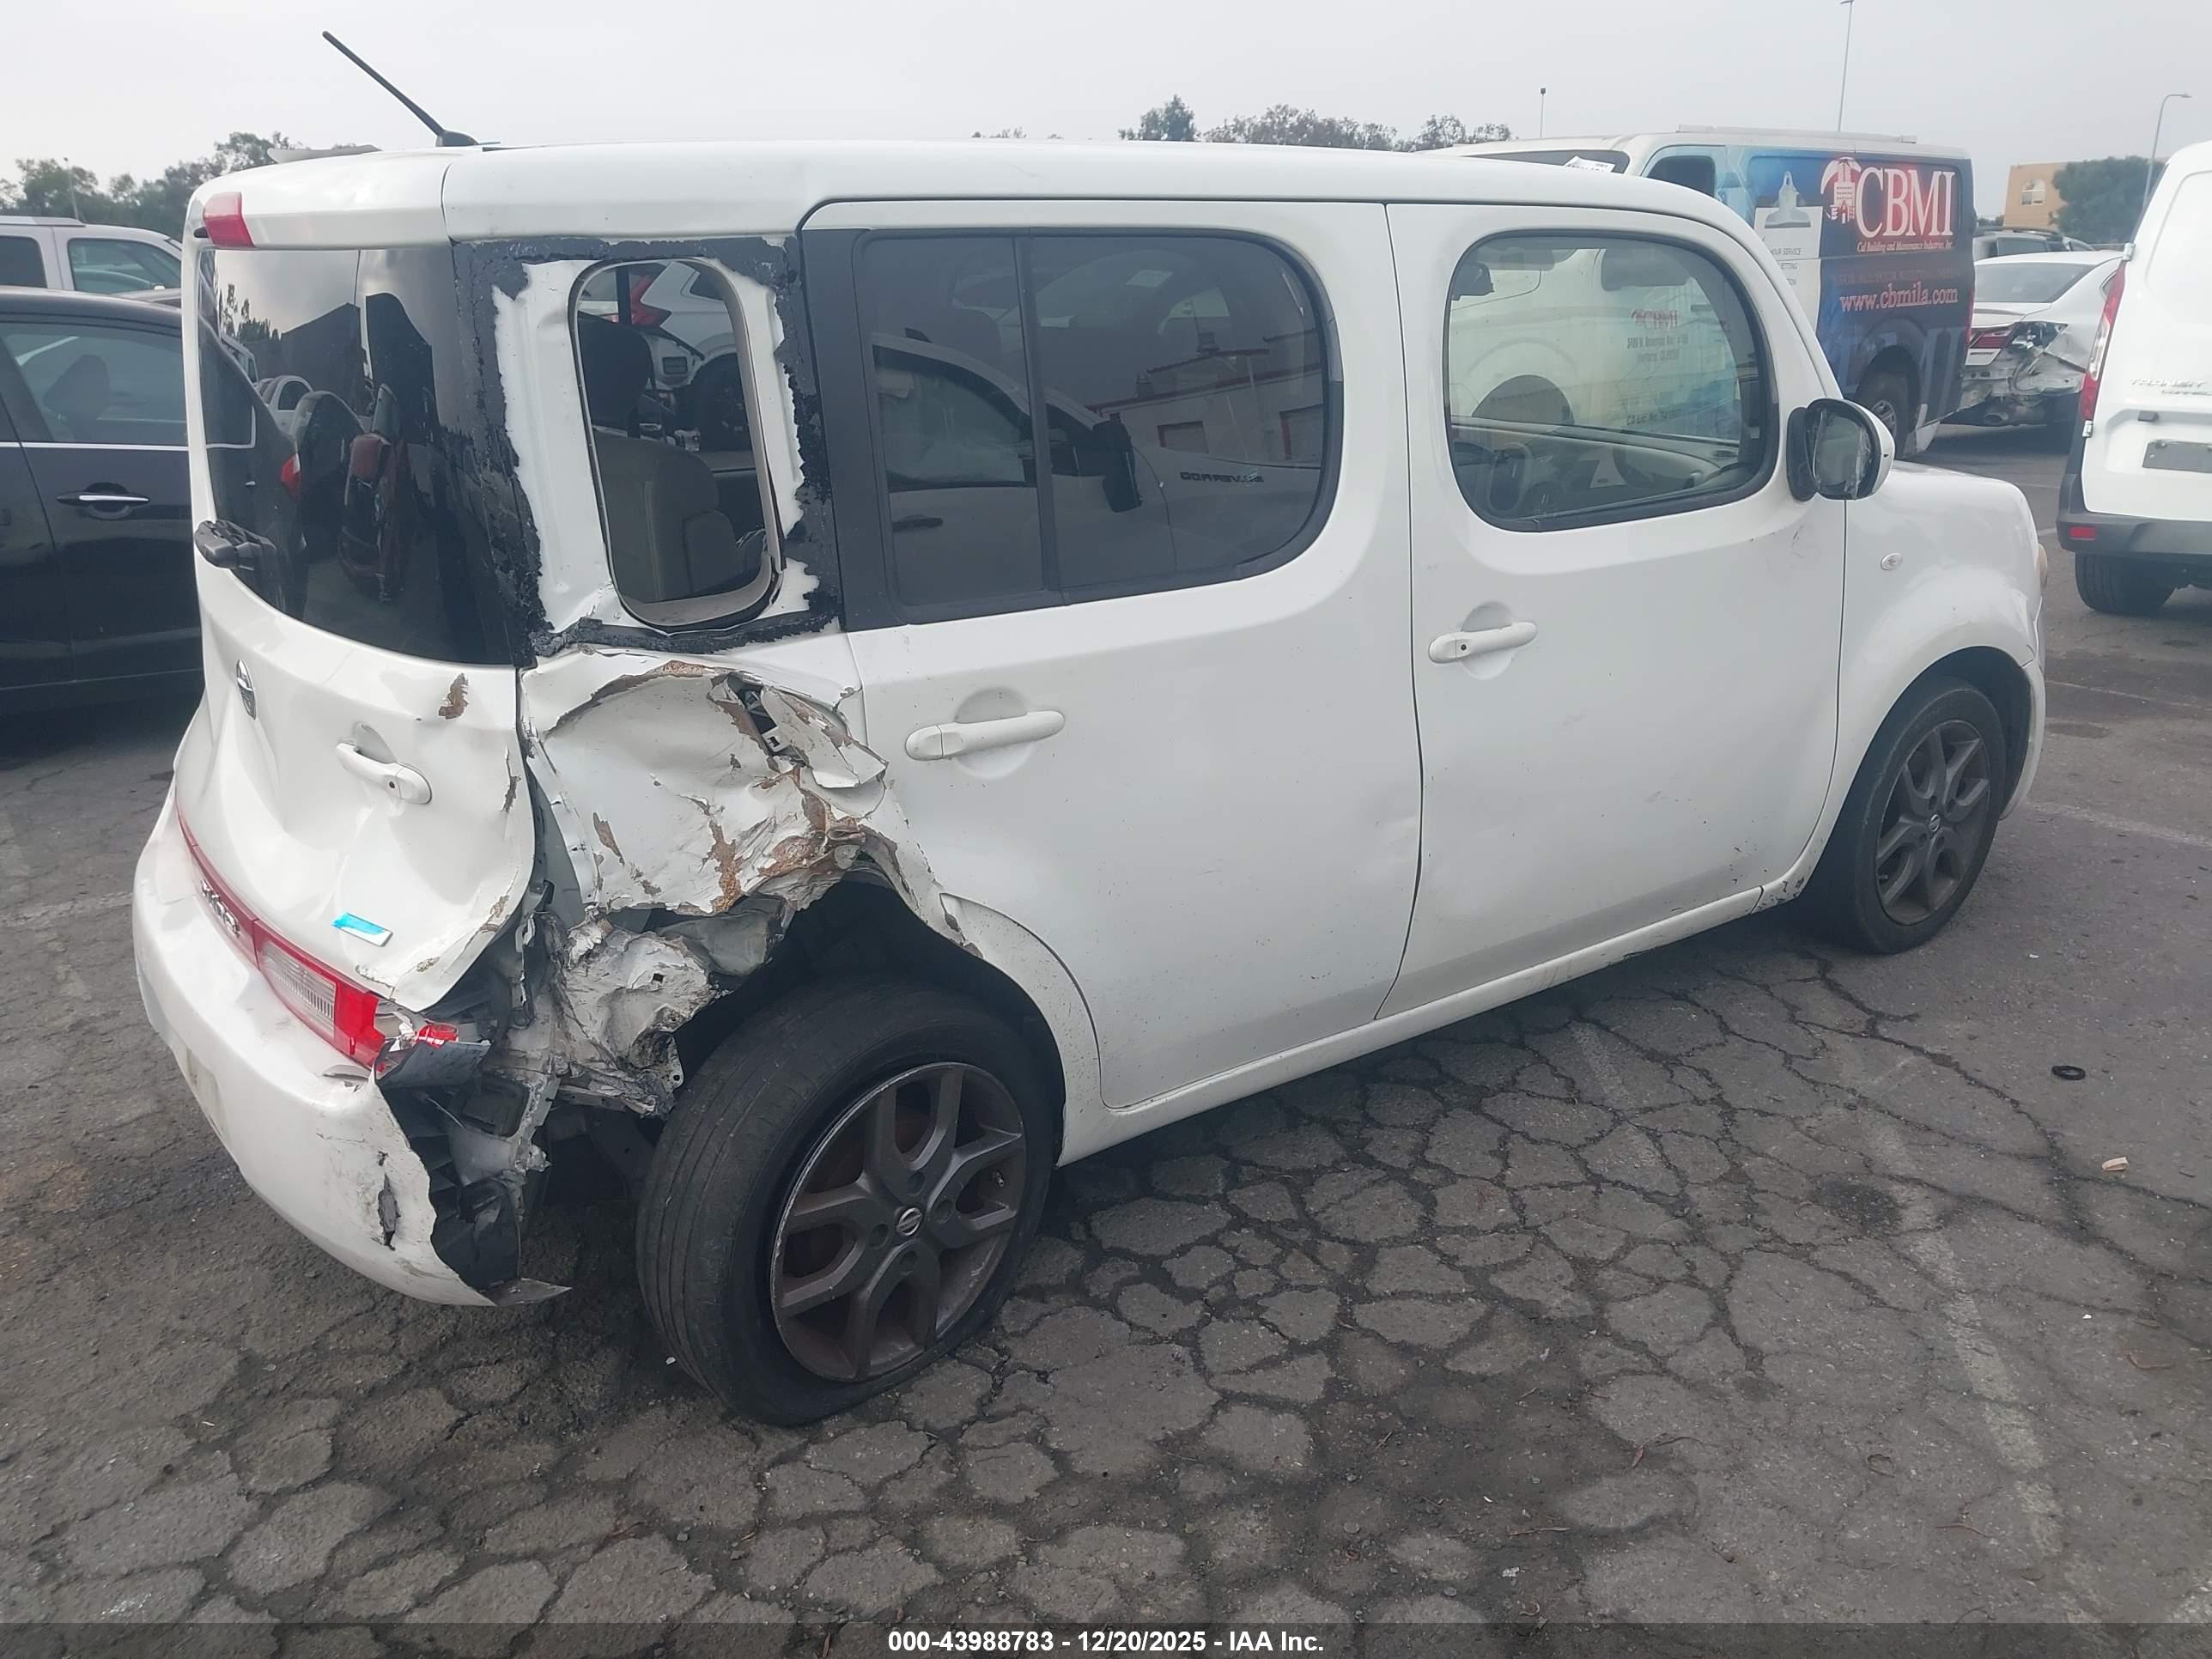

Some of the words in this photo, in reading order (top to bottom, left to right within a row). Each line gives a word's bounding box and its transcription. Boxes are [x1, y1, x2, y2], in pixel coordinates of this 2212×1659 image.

[1856, 167, 1955, 238] CBMI
[1839, 281, 1959, 312] www.cbmila.com
[2130, 378, 2209, 388] TRANSIT
